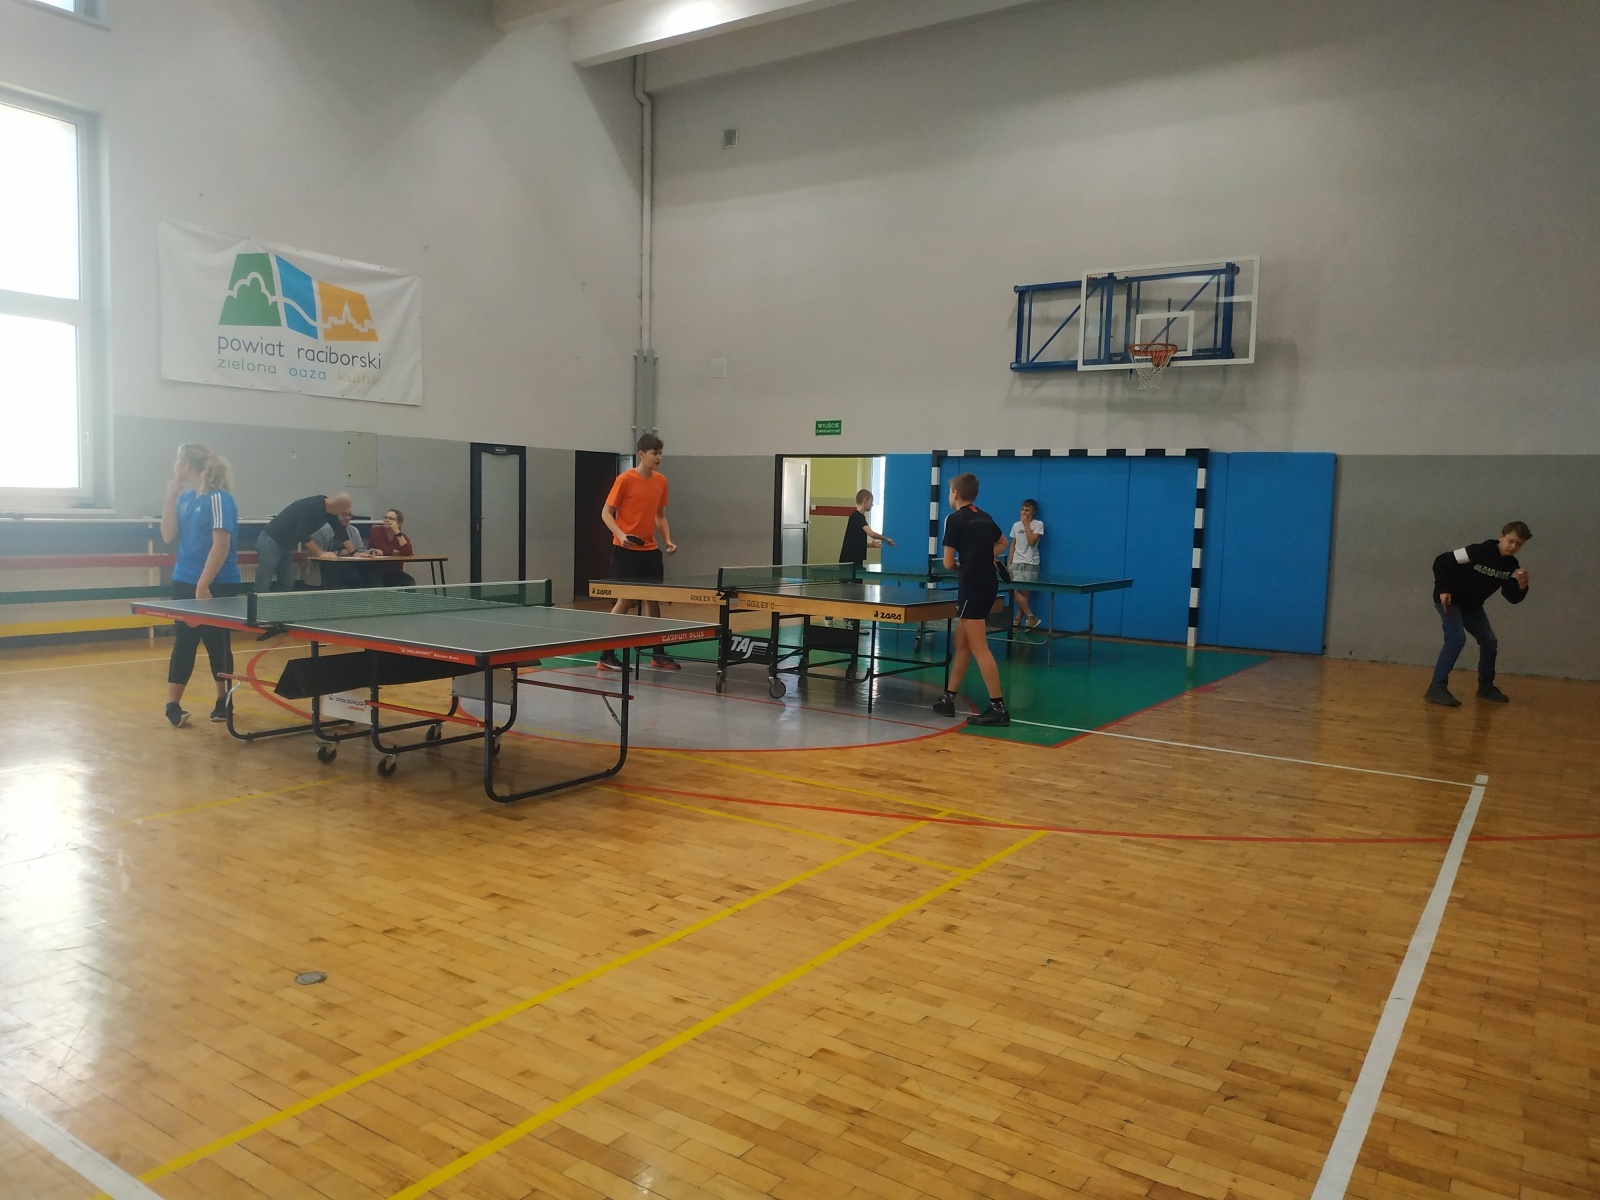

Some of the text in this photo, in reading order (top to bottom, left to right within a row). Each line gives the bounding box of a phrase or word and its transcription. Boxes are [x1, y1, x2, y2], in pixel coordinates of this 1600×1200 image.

[217, 336, 382, 370] powiat raciborski
[217, 358, 277, 374] zielona
[288, 367, 327, 380] oaza
[880, 612, 901, 620] ZARA
